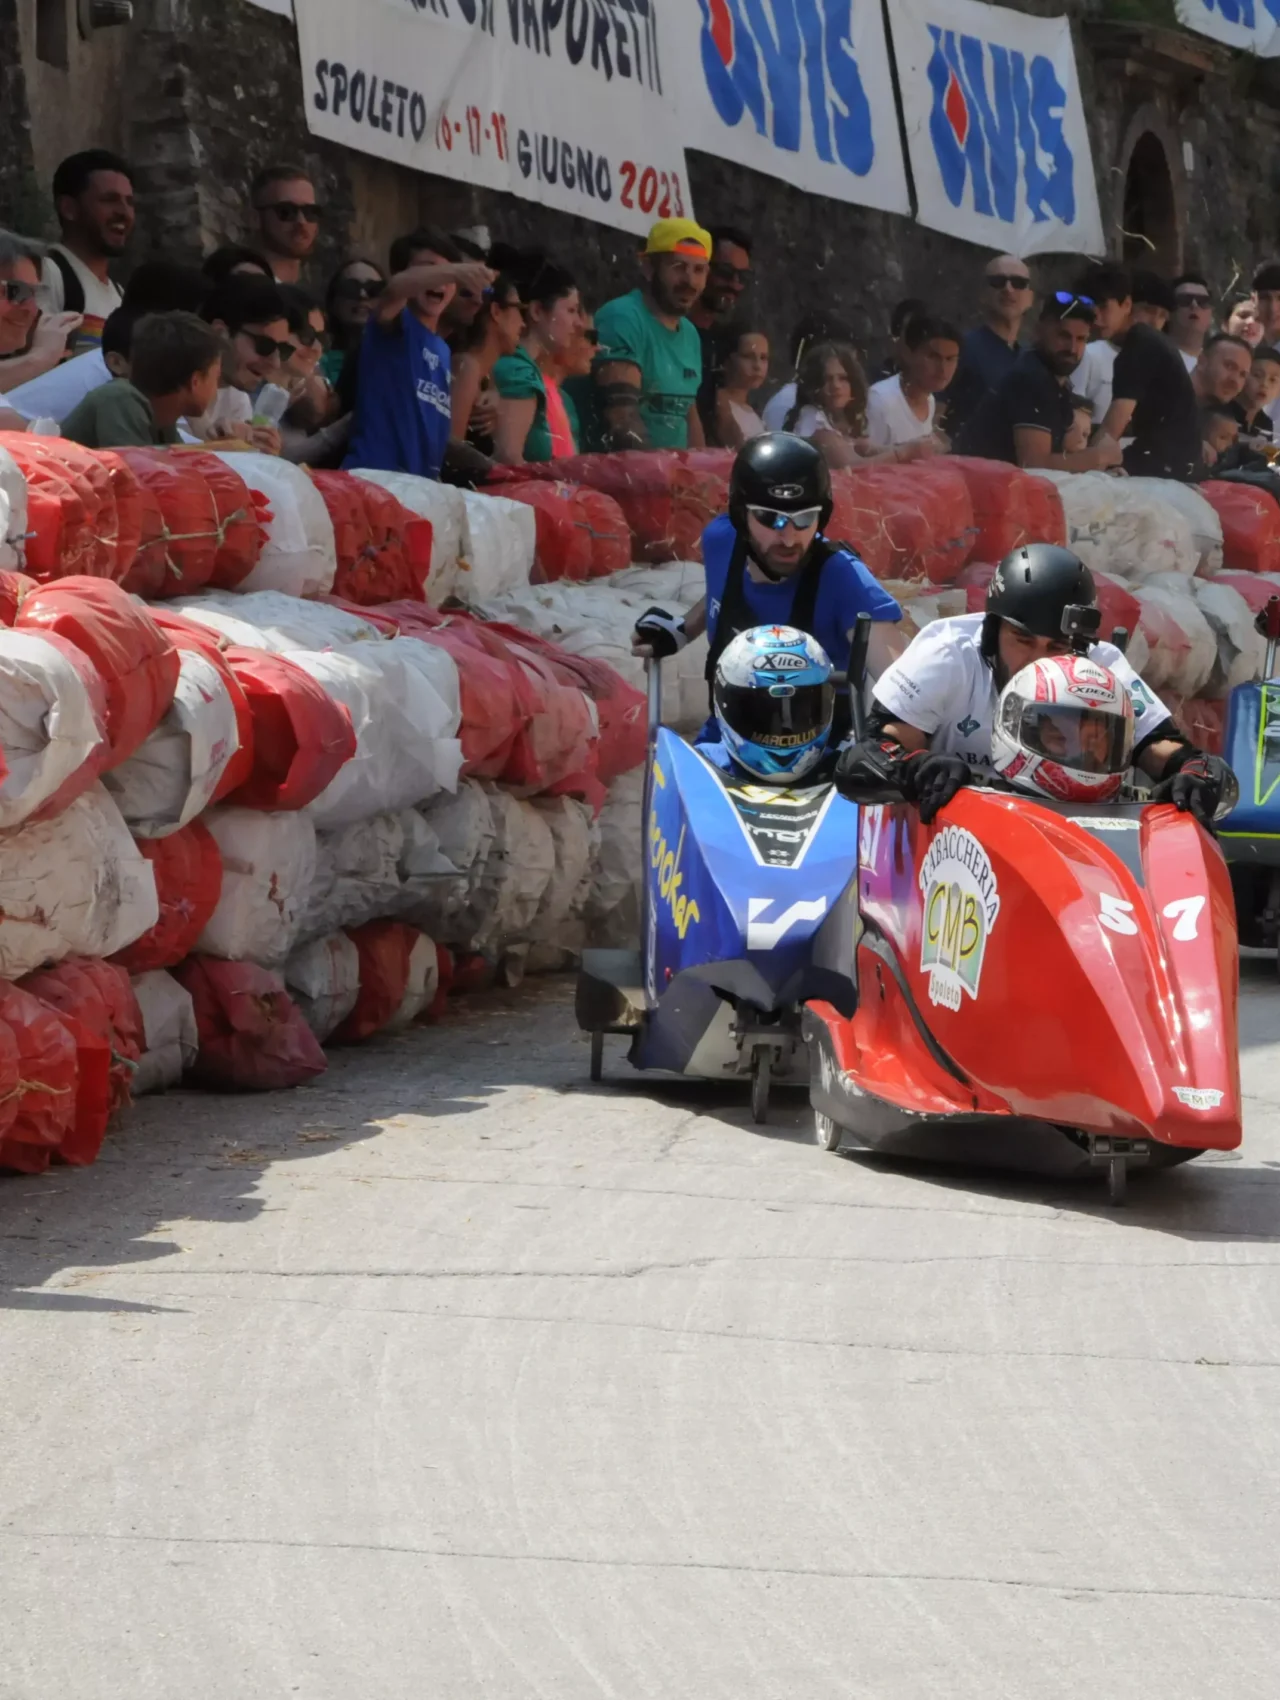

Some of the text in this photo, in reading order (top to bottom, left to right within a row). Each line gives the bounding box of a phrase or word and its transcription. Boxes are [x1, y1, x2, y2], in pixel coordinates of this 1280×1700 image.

[313, 59, 427, 143] SPOLETO
[517, 129, 613, 202] GIUGNO
[619, 160, 685, 219] 2023
[925, 22, 1076, 226] AVIS
[922, 831, 999, 926] TABACCHERIA
[926, 880, 981, 972] CMB
